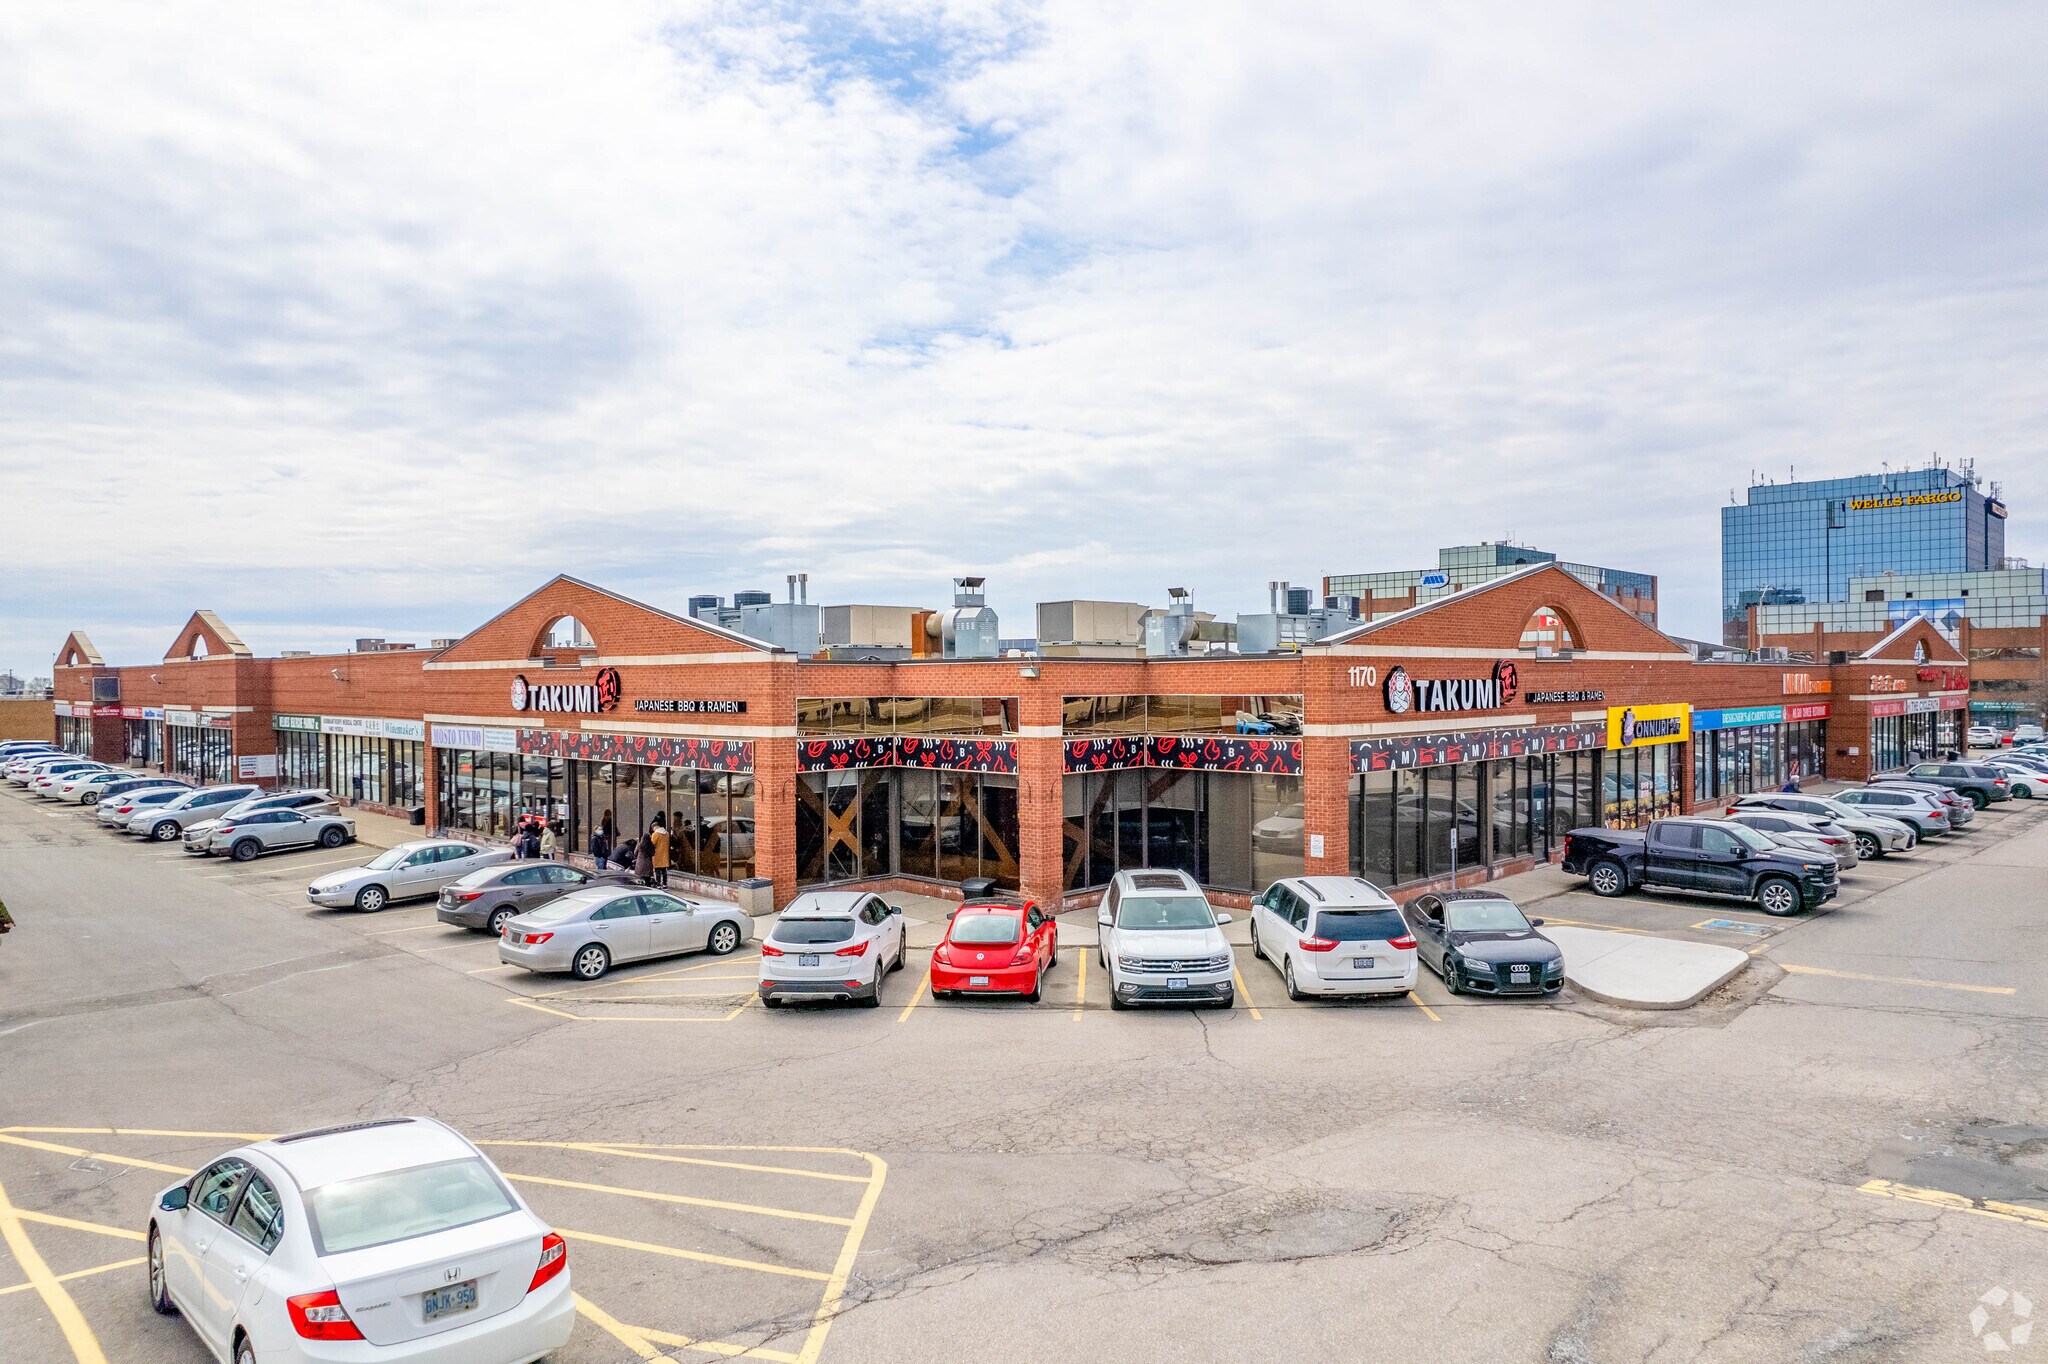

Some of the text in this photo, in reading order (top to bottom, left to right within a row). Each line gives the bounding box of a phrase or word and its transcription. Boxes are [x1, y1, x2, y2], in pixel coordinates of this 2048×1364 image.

[1849, 491, 1962, 510] WELLS FARGO
[1347, 666, 1377, 687] 1170
[528, 685, 600, 714] TAKUMI
[1416, 678, 1501, 712] TAKUMI
[1533, 691, 1565, 703] JAPANESE
[1566, 691, 1580, 702] BBQ
[1587, 690, 1606, 701] RAMEN
[634, 700, 739, 713] JAPANESE BBQ & RAMEN
[385, 722, 419, 736] Winemaker's
[458, 730, 481, 746] VINHO
[1636, 720, 1669, 738] ONNURI
[425, 1287, 476, 1314] BNJK 950
